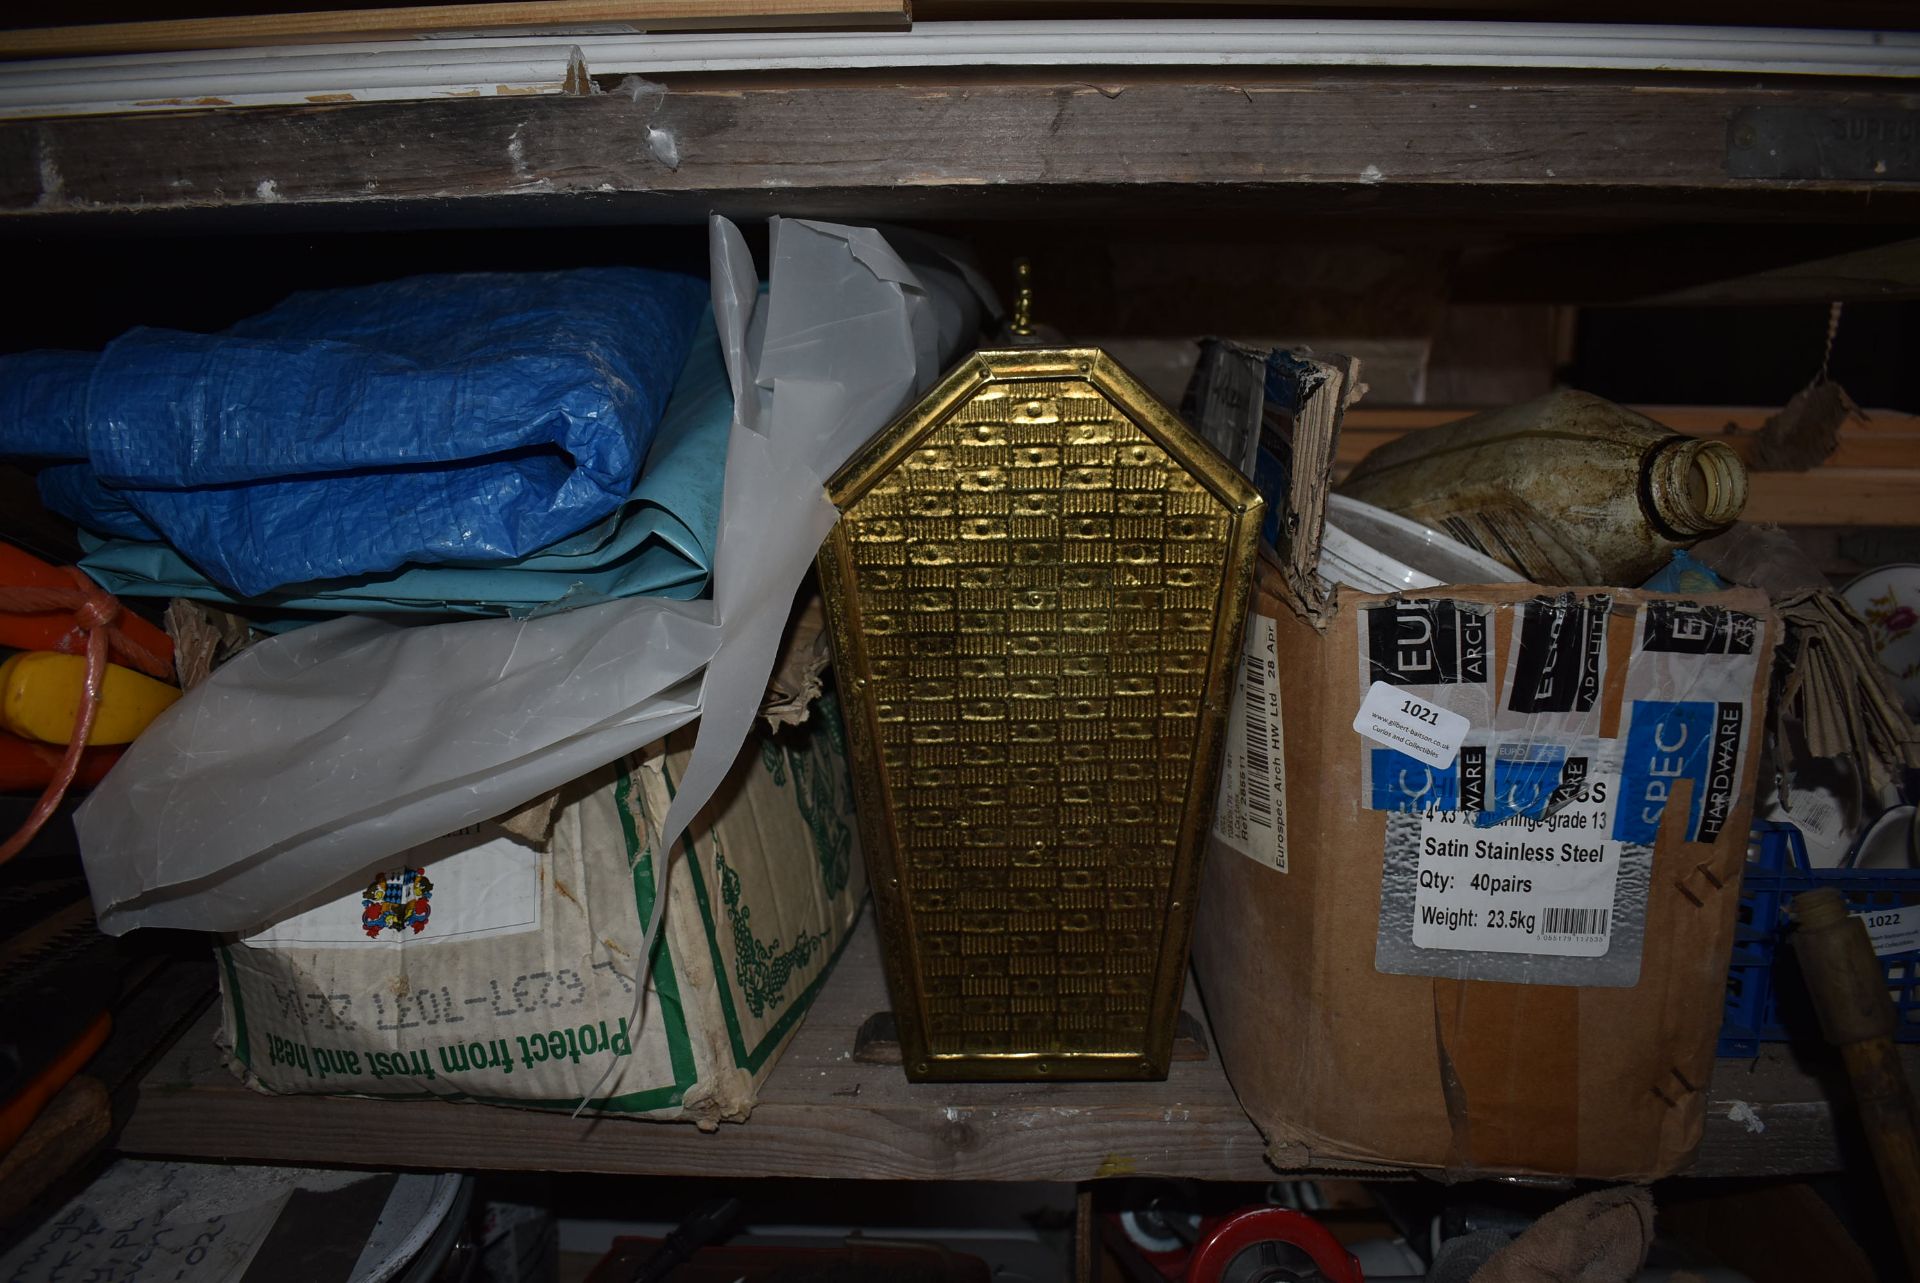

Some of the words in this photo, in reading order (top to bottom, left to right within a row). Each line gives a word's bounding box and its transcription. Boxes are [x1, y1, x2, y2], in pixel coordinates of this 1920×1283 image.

[1266, 625, 1277, 655] Apr
[1267, 659, 1277, 680] 28
[1268, 692, 1279, 718] Ltd
[1401, 700, 1439, 726] 1021
[1270, 723, 1281, 750] HW
[1372, 724, 1392, 739] Curios
[1391, 733, 1405, 743] and
[1404, 739, 1440, 759] Collectibles
[1273, 757, 1283, 793] Arch
[1705, 708, 1740, 834] HARDWARE
[1276, 799, 1286, 869] Eurospec
[1424, 837, 1469, 858] Satin
[1475, 839, 1555, 862] Stainless
[1560, 843, 1605, 864] Steel
[1420, 869, 1455, 893] Qty:
[1470, 873, 1533, 896] 40pairs
[1421, 905, 1479, 931] Weight:
[1486, 909, 1537, 934] 23.5kg
[1868, 914, 1901, 928] 1022
[266, 1032, 313, 1077] heat
[439, 1038, 515, 1074] from
[516, 1017, 633, 1069] Protect
[312, 1047, 363, 1079] and
[364, 1047, 436, 1080] frost
